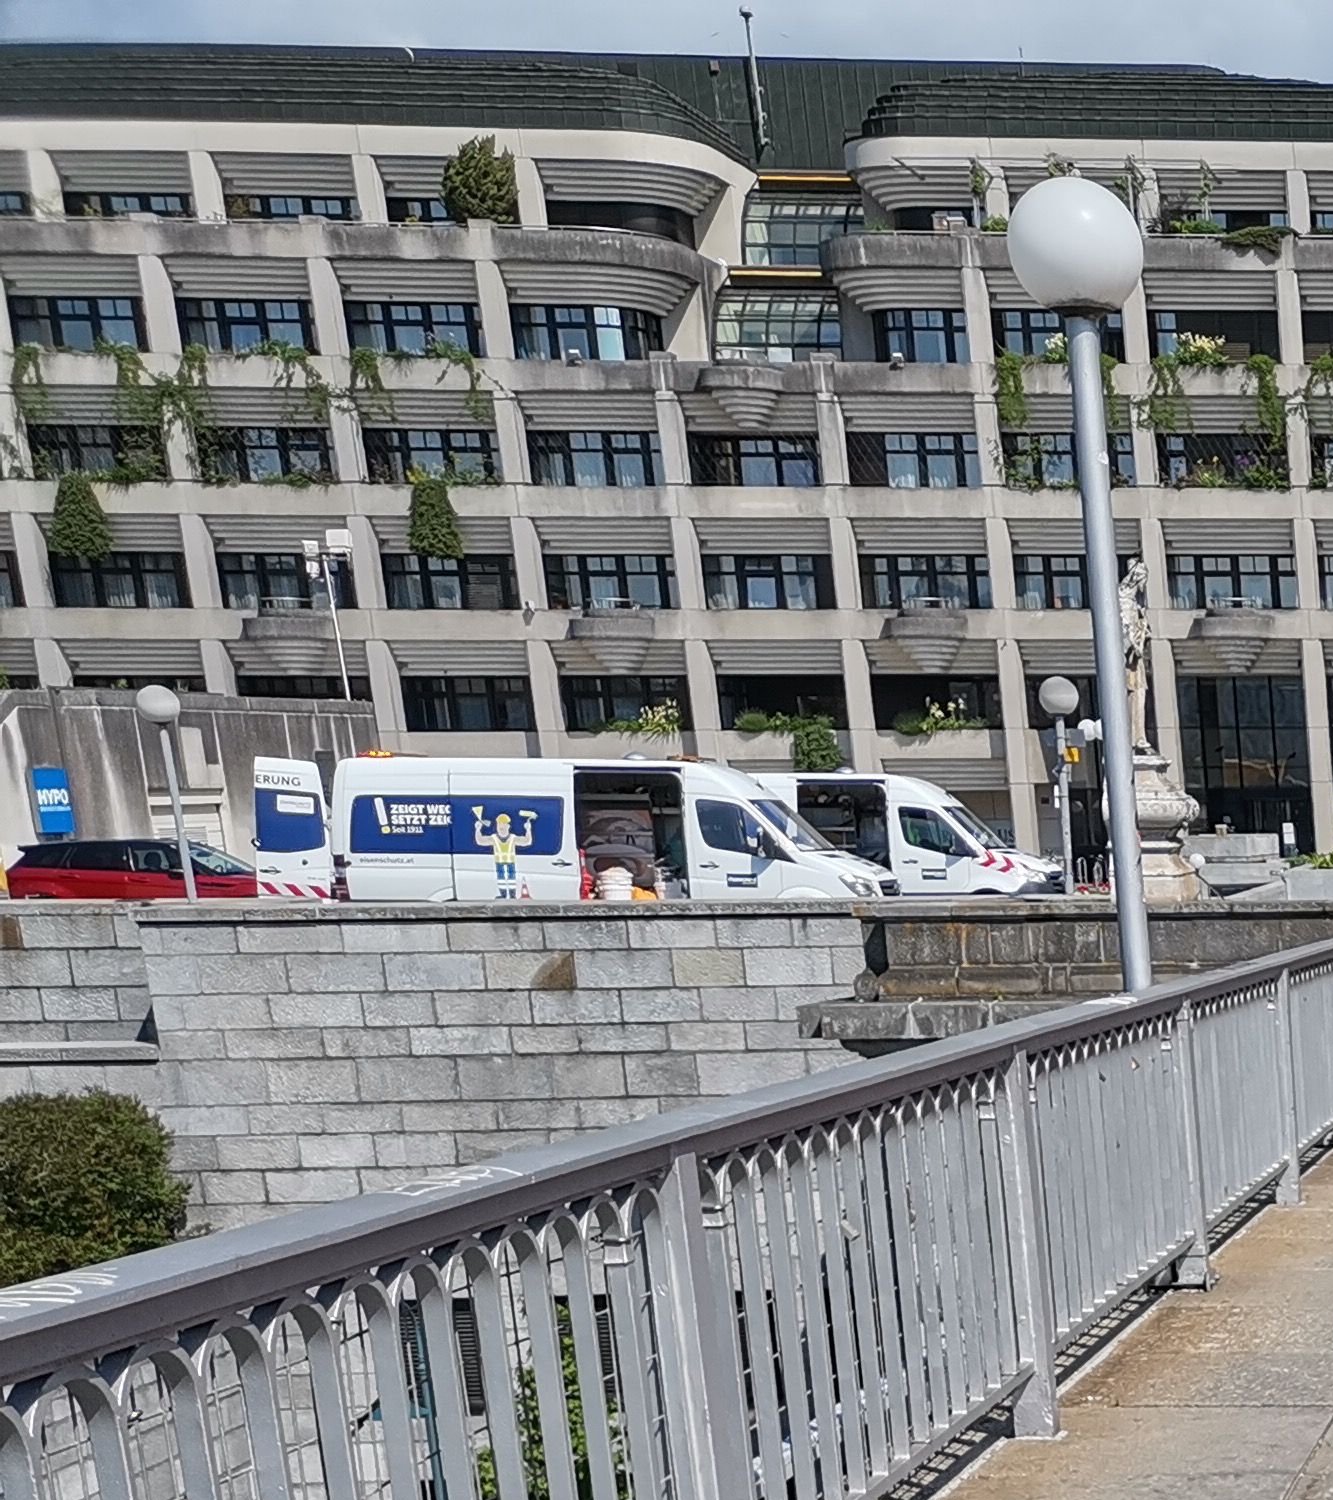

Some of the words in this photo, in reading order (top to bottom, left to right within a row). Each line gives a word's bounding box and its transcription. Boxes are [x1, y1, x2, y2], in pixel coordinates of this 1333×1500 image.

[254, 774, 301, 787] ERUNG
[36, 788, 69, 806] HYPO
[390, 804, 425, 814] ZEIGT
[390, 815, 426, 825] SETZT
